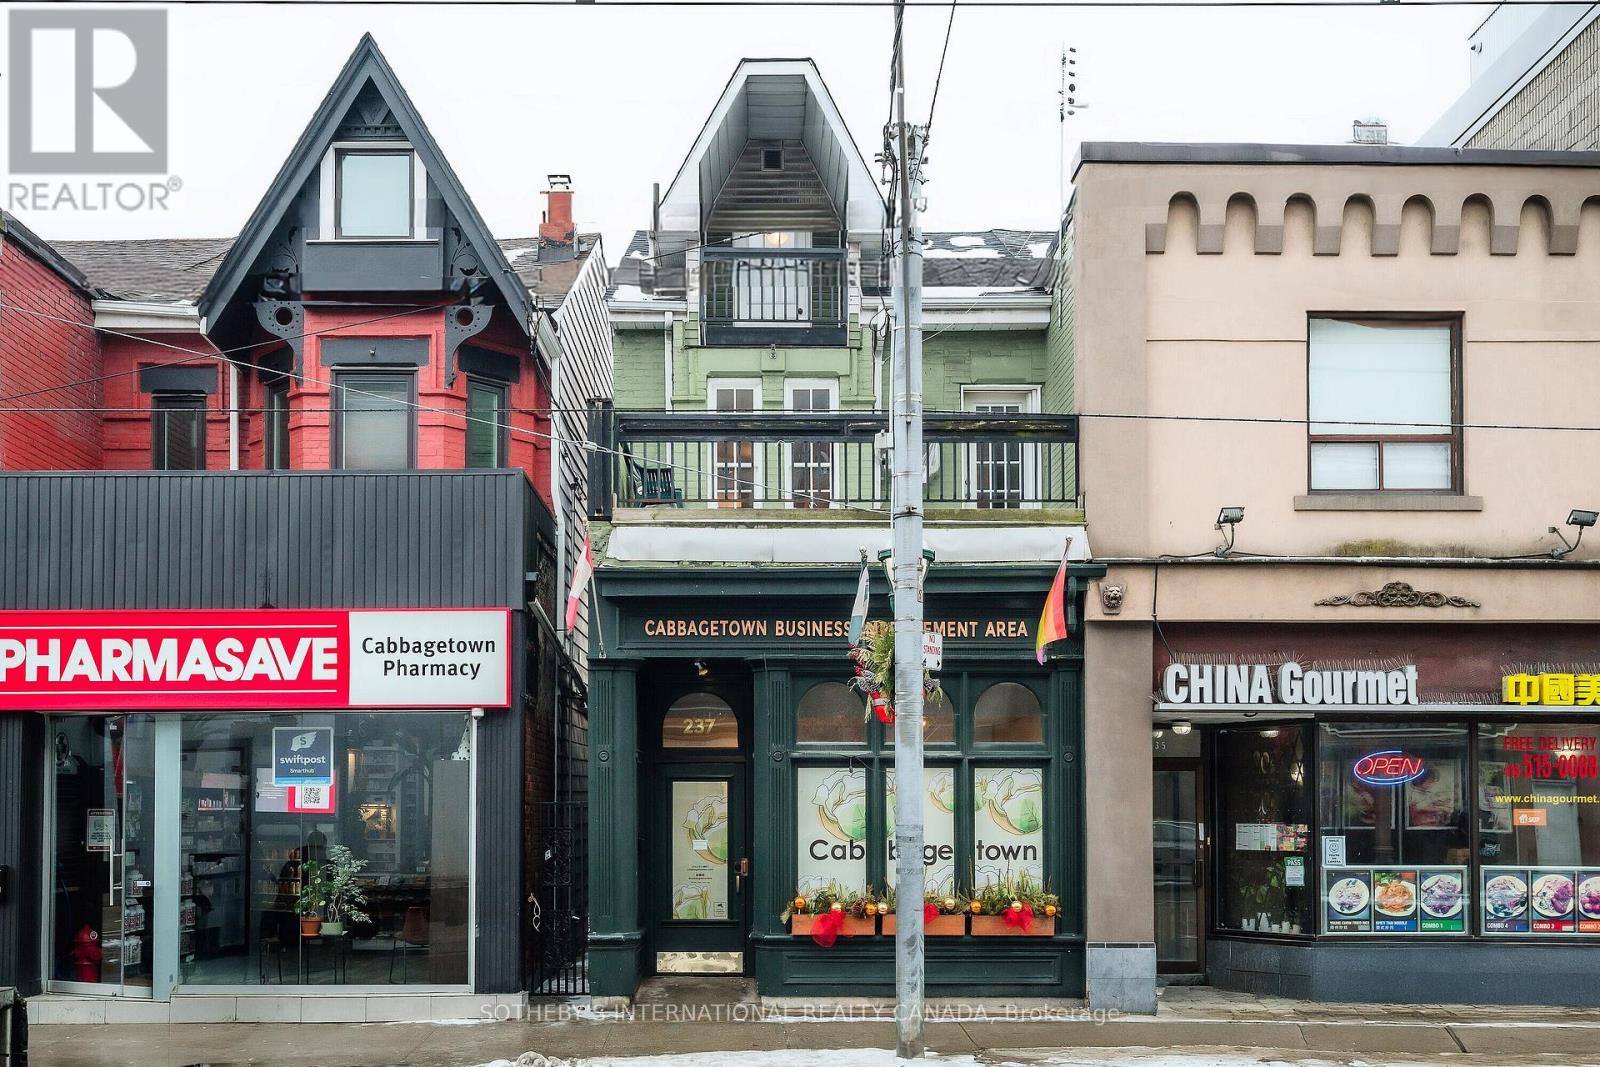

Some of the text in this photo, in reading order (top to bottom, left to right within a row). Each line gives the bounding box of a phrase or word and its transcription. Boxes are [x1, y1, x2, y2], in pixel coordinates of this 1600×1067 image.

[645, 620, 767, 637] CABBAGETOWN
[985, 621, 1028, 638] AREA
[362, 637, 495, 657] Cabbagetown
[929, 635, 936, 643] NO
[0, 637, 337, 682] PHARMASAVE
[384, 659, 481, 680] Pharmacy
[1163, 662, 1419, 705] CHINA Gourmet
[683, 718, 716, 734] 237
[1503, 736, 1596, 751] FREE DELIVERY
[280, 755, 326, 766] swiftpost
[1356, 757, 1421, 775] OPEN
[976, 839, 1037, 861] town
